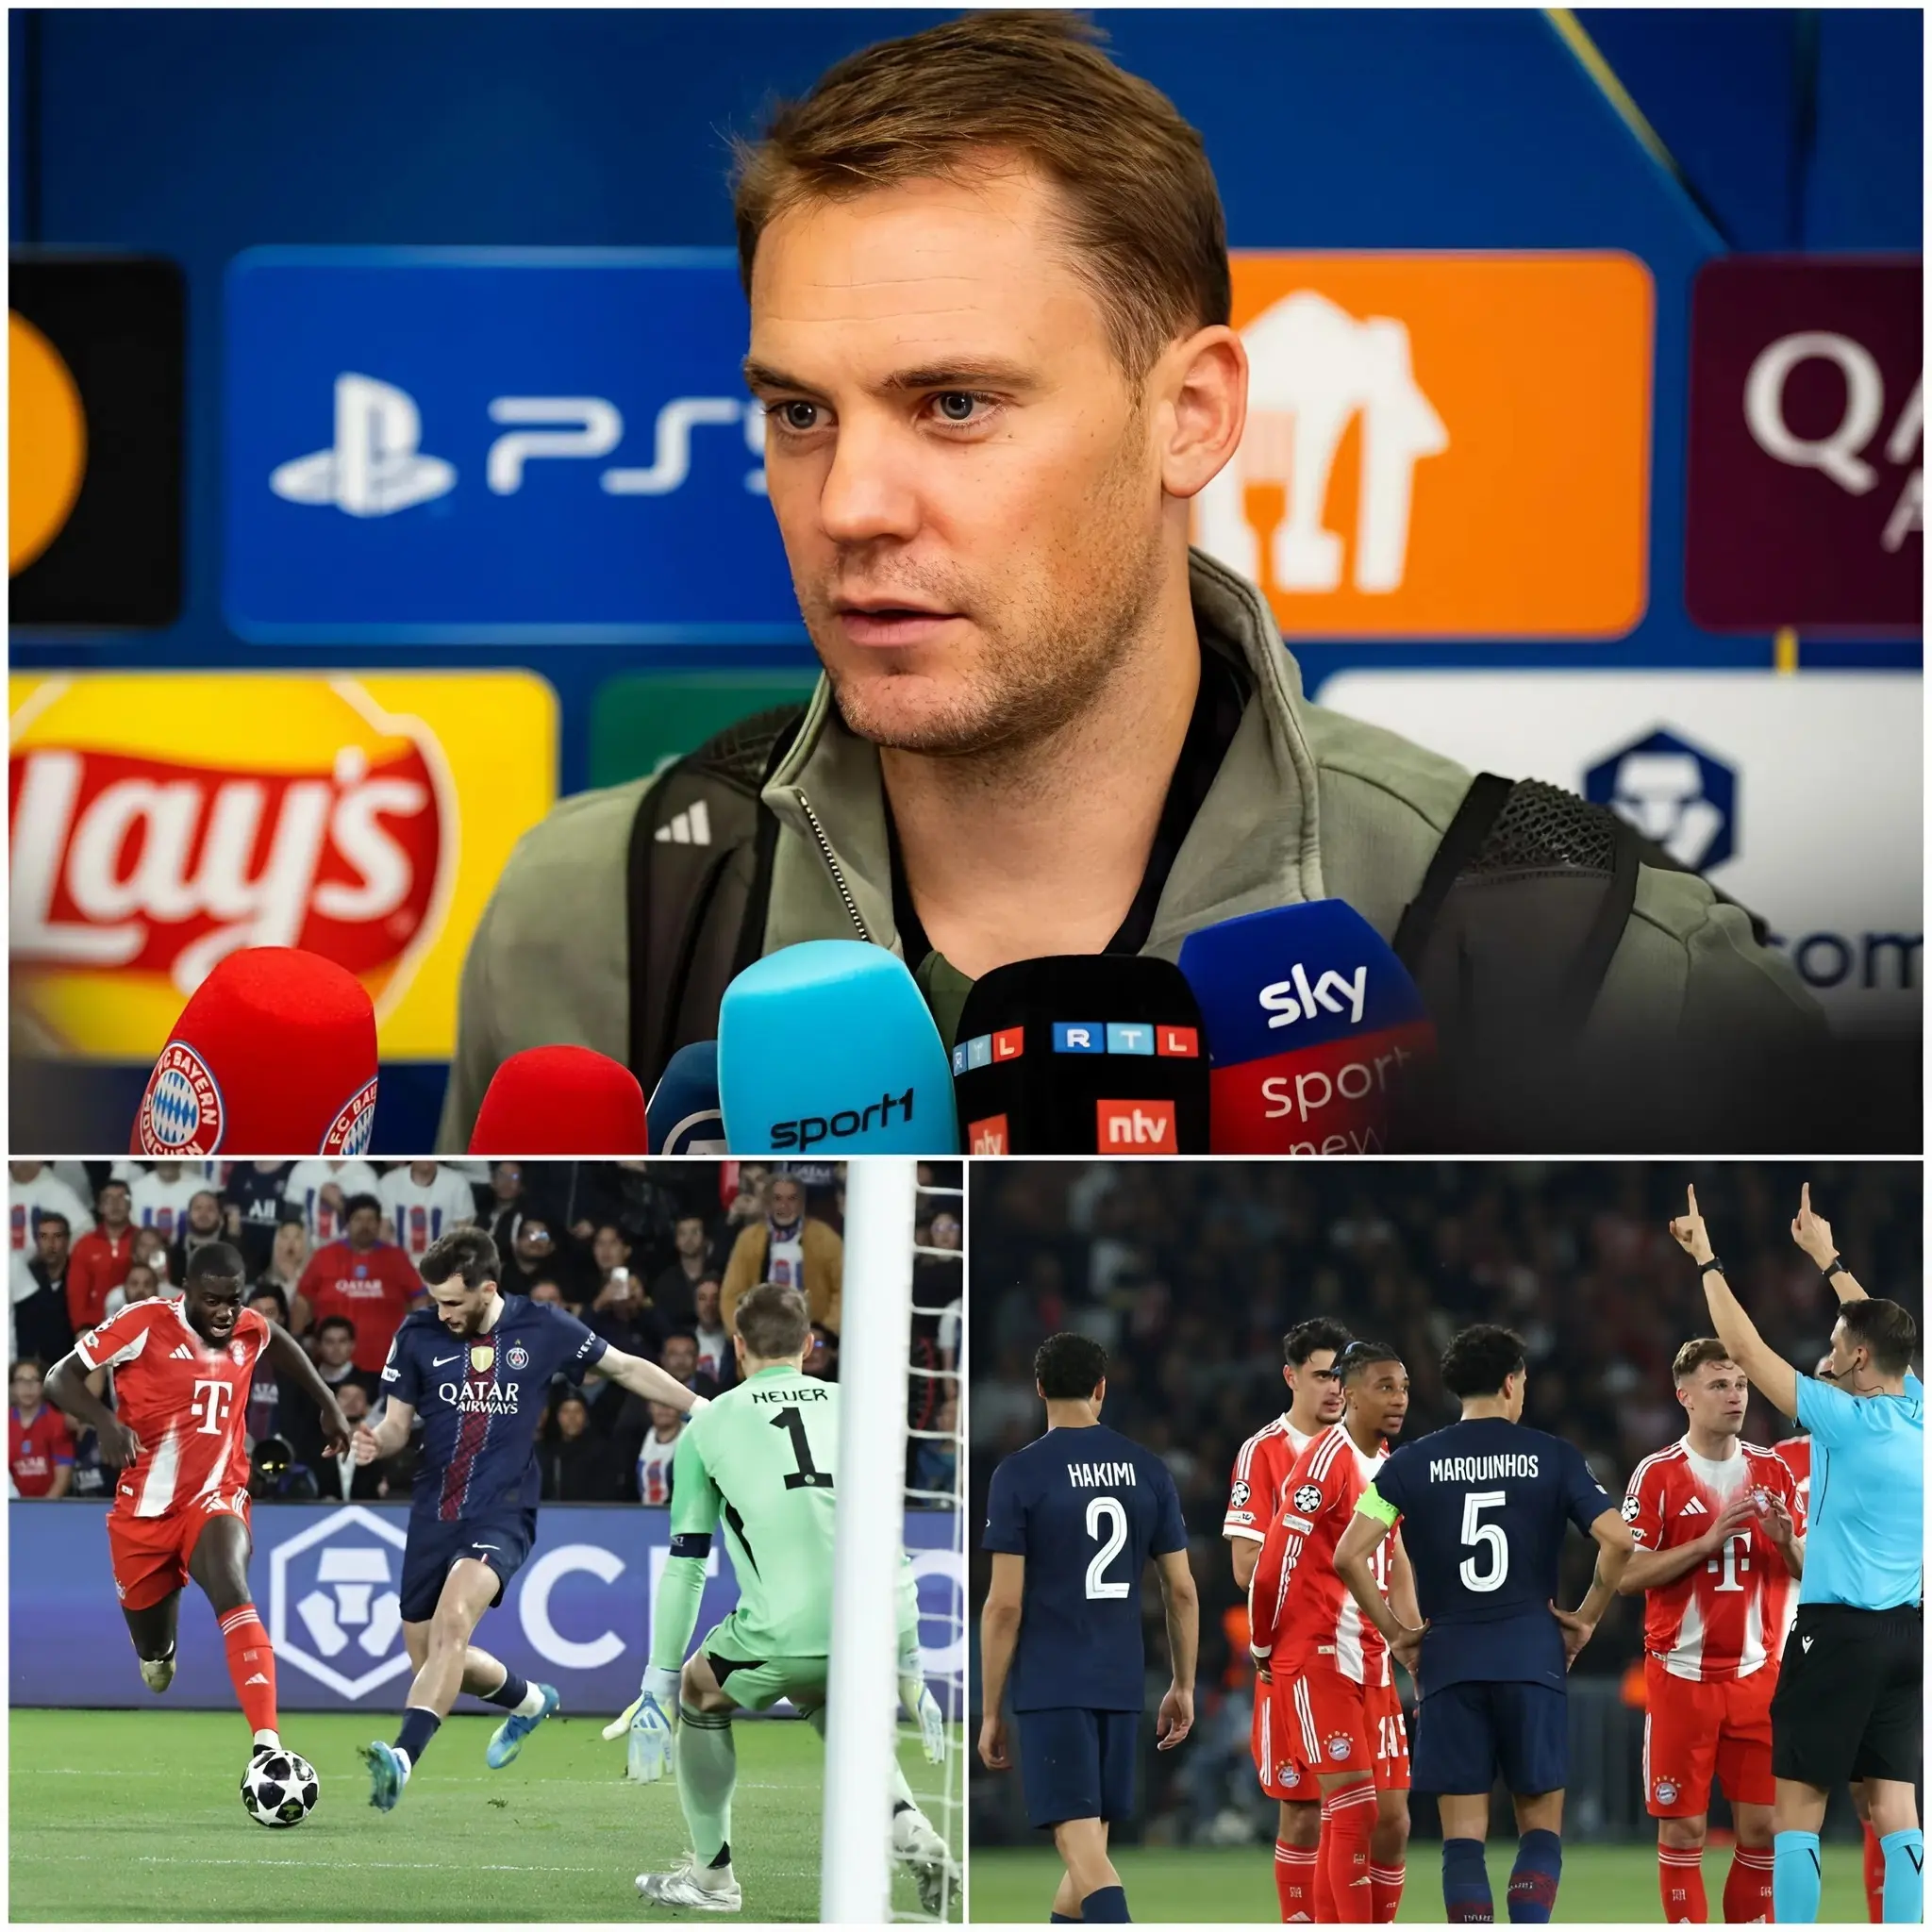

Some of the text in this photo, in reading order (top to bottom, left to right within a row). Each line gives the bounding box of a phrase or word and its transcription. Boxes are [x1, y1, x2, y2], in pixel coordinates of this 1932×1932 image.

[486, 395, 768, 495] PS
[9, 746, 429, 999] Lay's
[1768, 928, 1924, 989] om
[1259, 962, 1367, 1029] sky
[1067, 1029, 1188, 1053] RTL
[174, 1050, 218, 1125] BAYERN
[1261, 1046, 1412, 1123] sport
[328, 1117, 350, 1144] FC
[770, 1087, 913, 1153] sport1
[1108, 1108, 1167, 1143] ntv
[439, 1381, 519, 1405] QATAR
[456, 1400, 518, 1414] AIRWAYS
[752, 1389, 828, 1404] NEUER
[769, 1407, 834, 1491] 1
[1068, 1462, 1136, 1487] HAKIMI
[1429, 1454, 1539, 1483] MARQUINHOS
[1086, 1496, 1130, 1599] 2
[1459, 1491, 1509, 1592] 5
